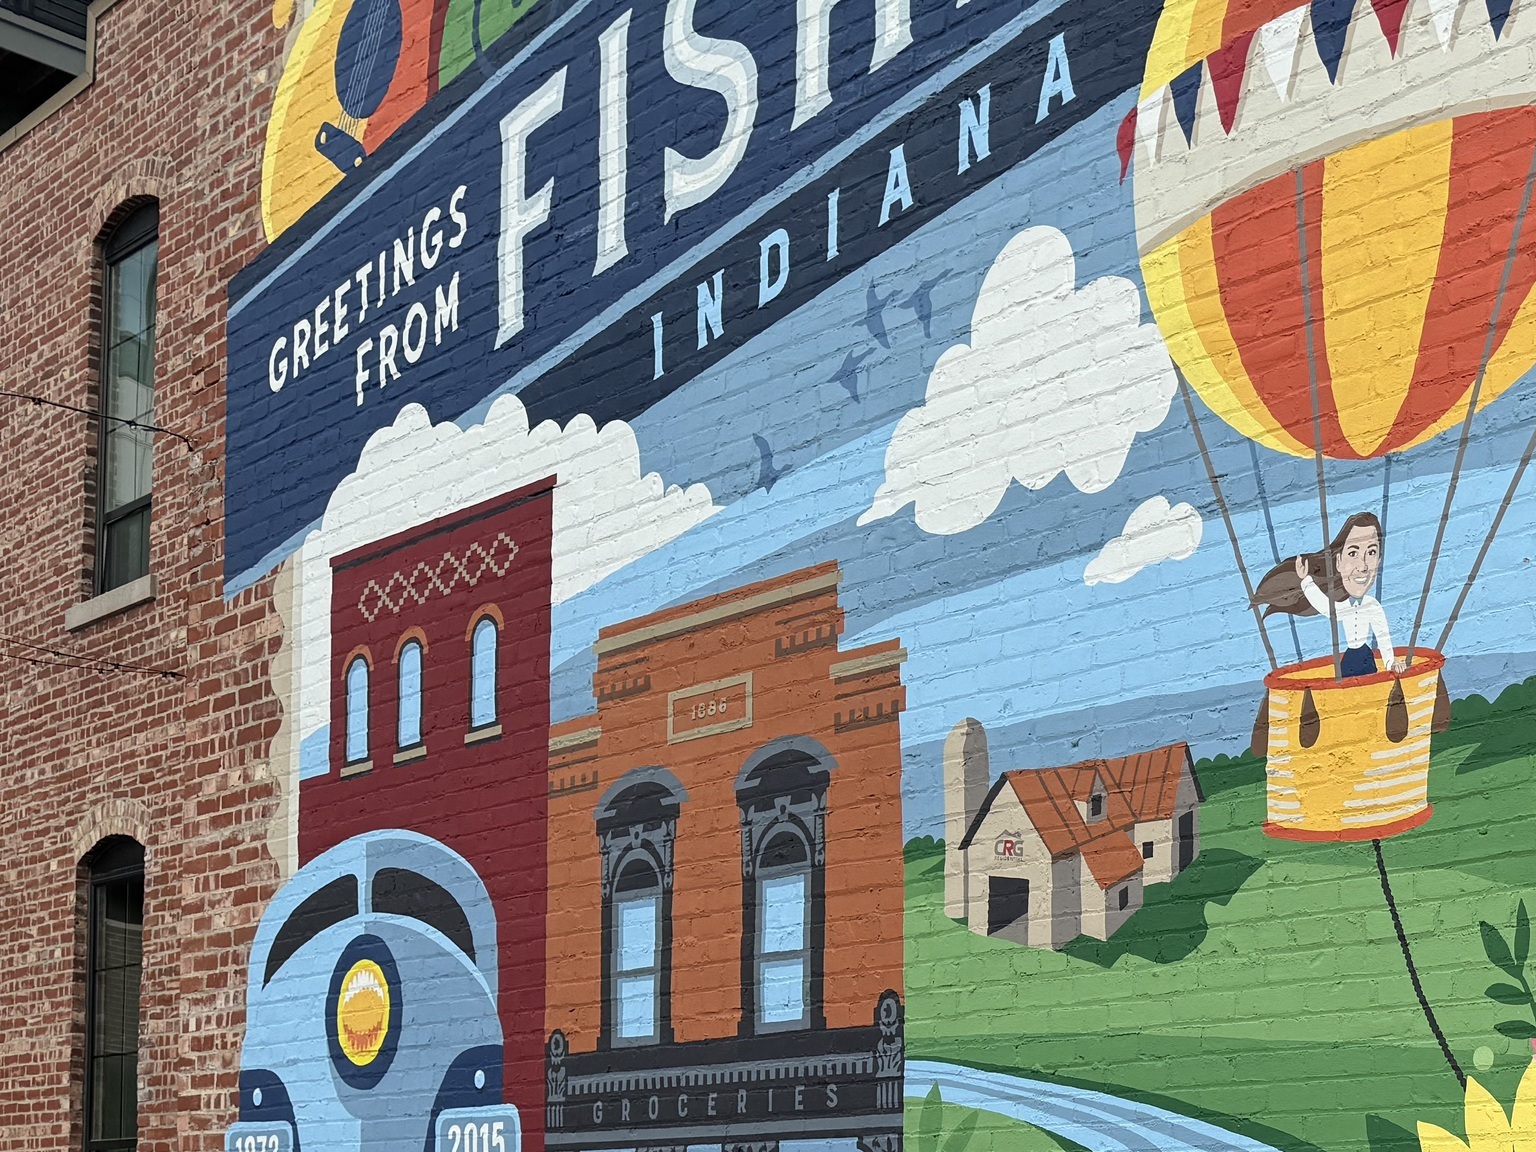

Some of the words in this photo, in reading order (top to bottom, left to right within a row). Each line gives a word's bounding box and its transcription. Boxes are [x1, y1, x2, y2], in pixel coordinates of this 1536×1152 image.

[650, 31, 1077, 382] INDIANA
[268, 184, 468, 393] GREETINGS
[355, 271, 460, 407] FROM
[994, 839, 1025, 857] CRG
[592, 1084, 839, 1124] GROCERIES
